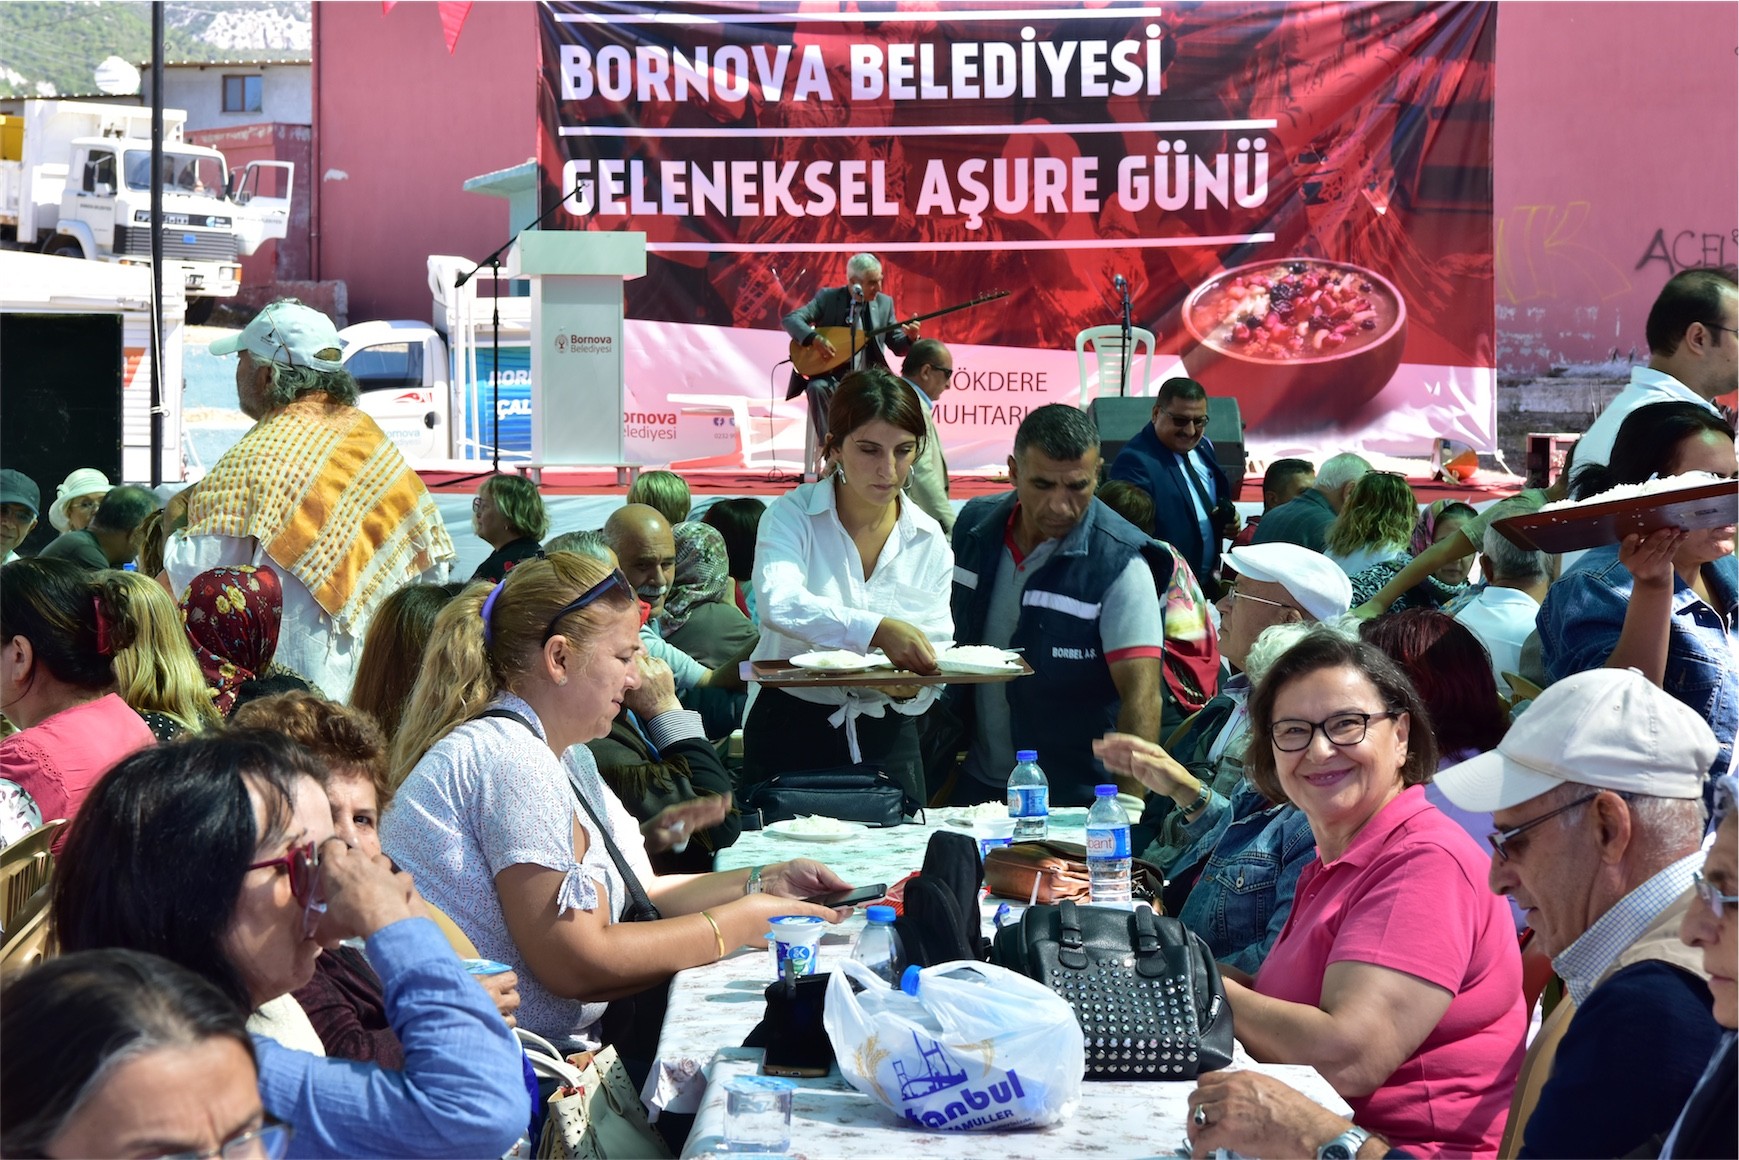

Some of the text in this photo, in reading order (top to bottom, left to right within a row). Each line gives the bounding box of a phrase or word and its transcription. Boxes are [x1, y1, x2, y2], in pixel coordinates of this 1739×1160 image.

[559, 25, 1162, 102] BORNOVA BELEDİYESİ
[562, 137, 1270, 231] GELENEKSEL AŞURE GÜNÜ
[570, 334, 612, 344] Bornova
[570, 344, 612, 355] Belediyesi
[953, 367, 1048, 392] ÖKDERE
[623, 412, 677, 425] ornova
[387, 429, 421, 439] ornova
[623, 425, 677, 442] lediyesi
[1052, 646, 1084, 660] BORBEL
[1087, 837, 1113, 850] bant
[904, 1068, 1026, 1130] tanbul
